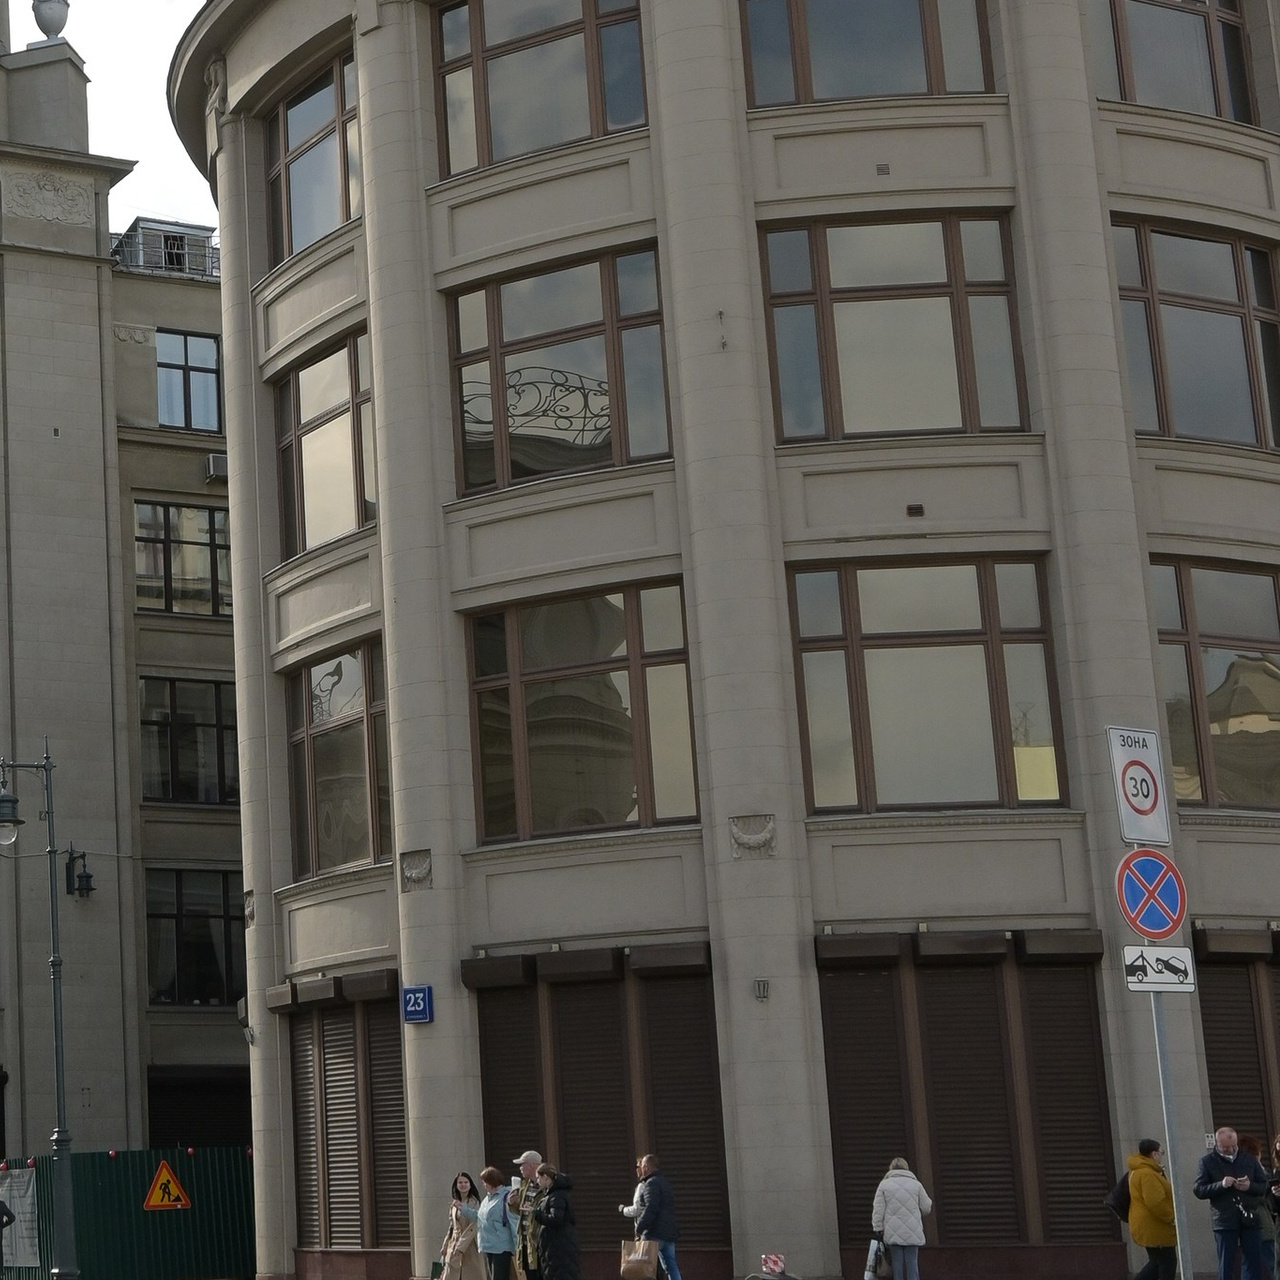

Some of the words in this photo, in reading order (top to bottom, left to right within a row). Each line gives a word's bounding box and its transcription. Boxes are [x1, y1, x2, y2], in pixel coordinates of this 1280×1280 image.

[1119, 734, 1149, 749] ЗОНА
[1129, 776, 1150, 799] 30
[406, 992, 424, 1011] 23
